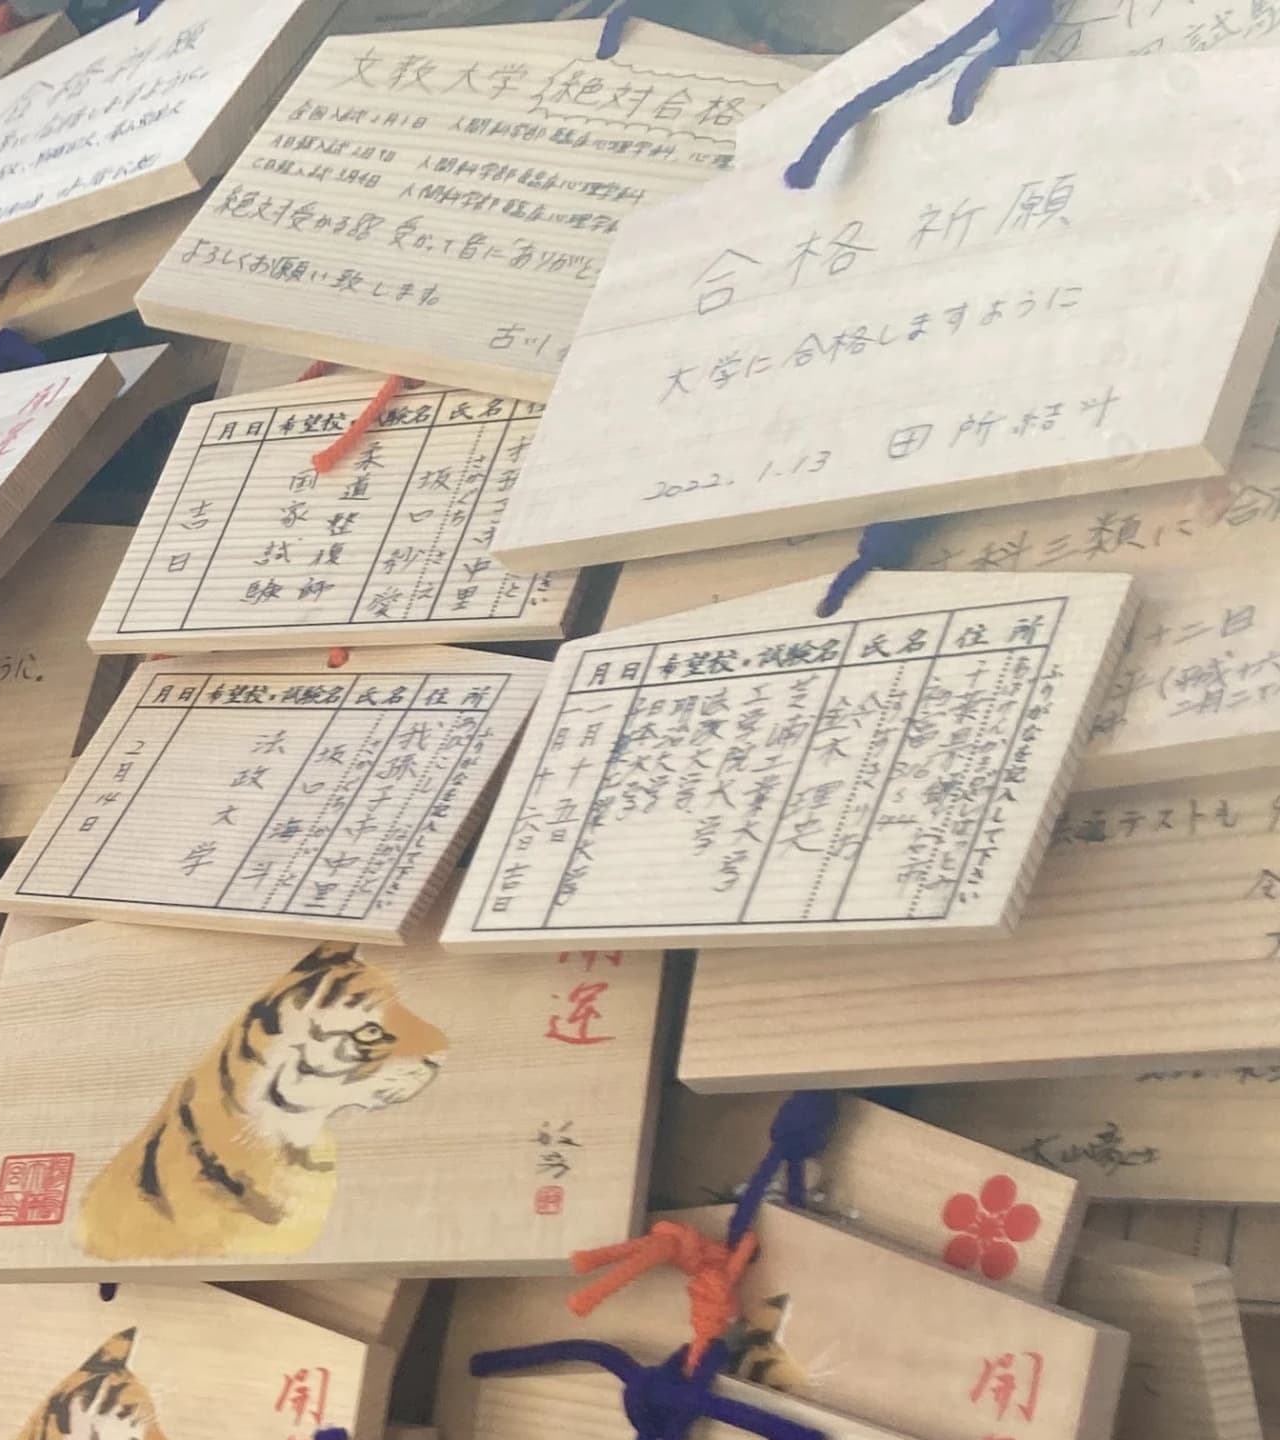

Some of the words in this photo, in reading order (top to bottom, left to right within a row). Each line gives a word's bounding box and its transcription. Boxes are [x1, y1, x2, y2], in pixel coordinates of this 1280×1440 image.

[691, 172, 1078, 317] 合格祈願
[657, 285, 1087, 403] 大学に合格しますように
[277, 402, 435, 438] 希望校・験名
[448, 397, 506, 421] 氏名
[216, 418, 269, 444] 月日
[168, 499, 211, 574] 吉日
[861, 626, 929, 660] 氏名
[954, 614, 1046, 650] 住所
[154, 684, 195, 704] 月日
[354, 685, 409, 706] 氏名
[424, 684, 492, 709] 住所
